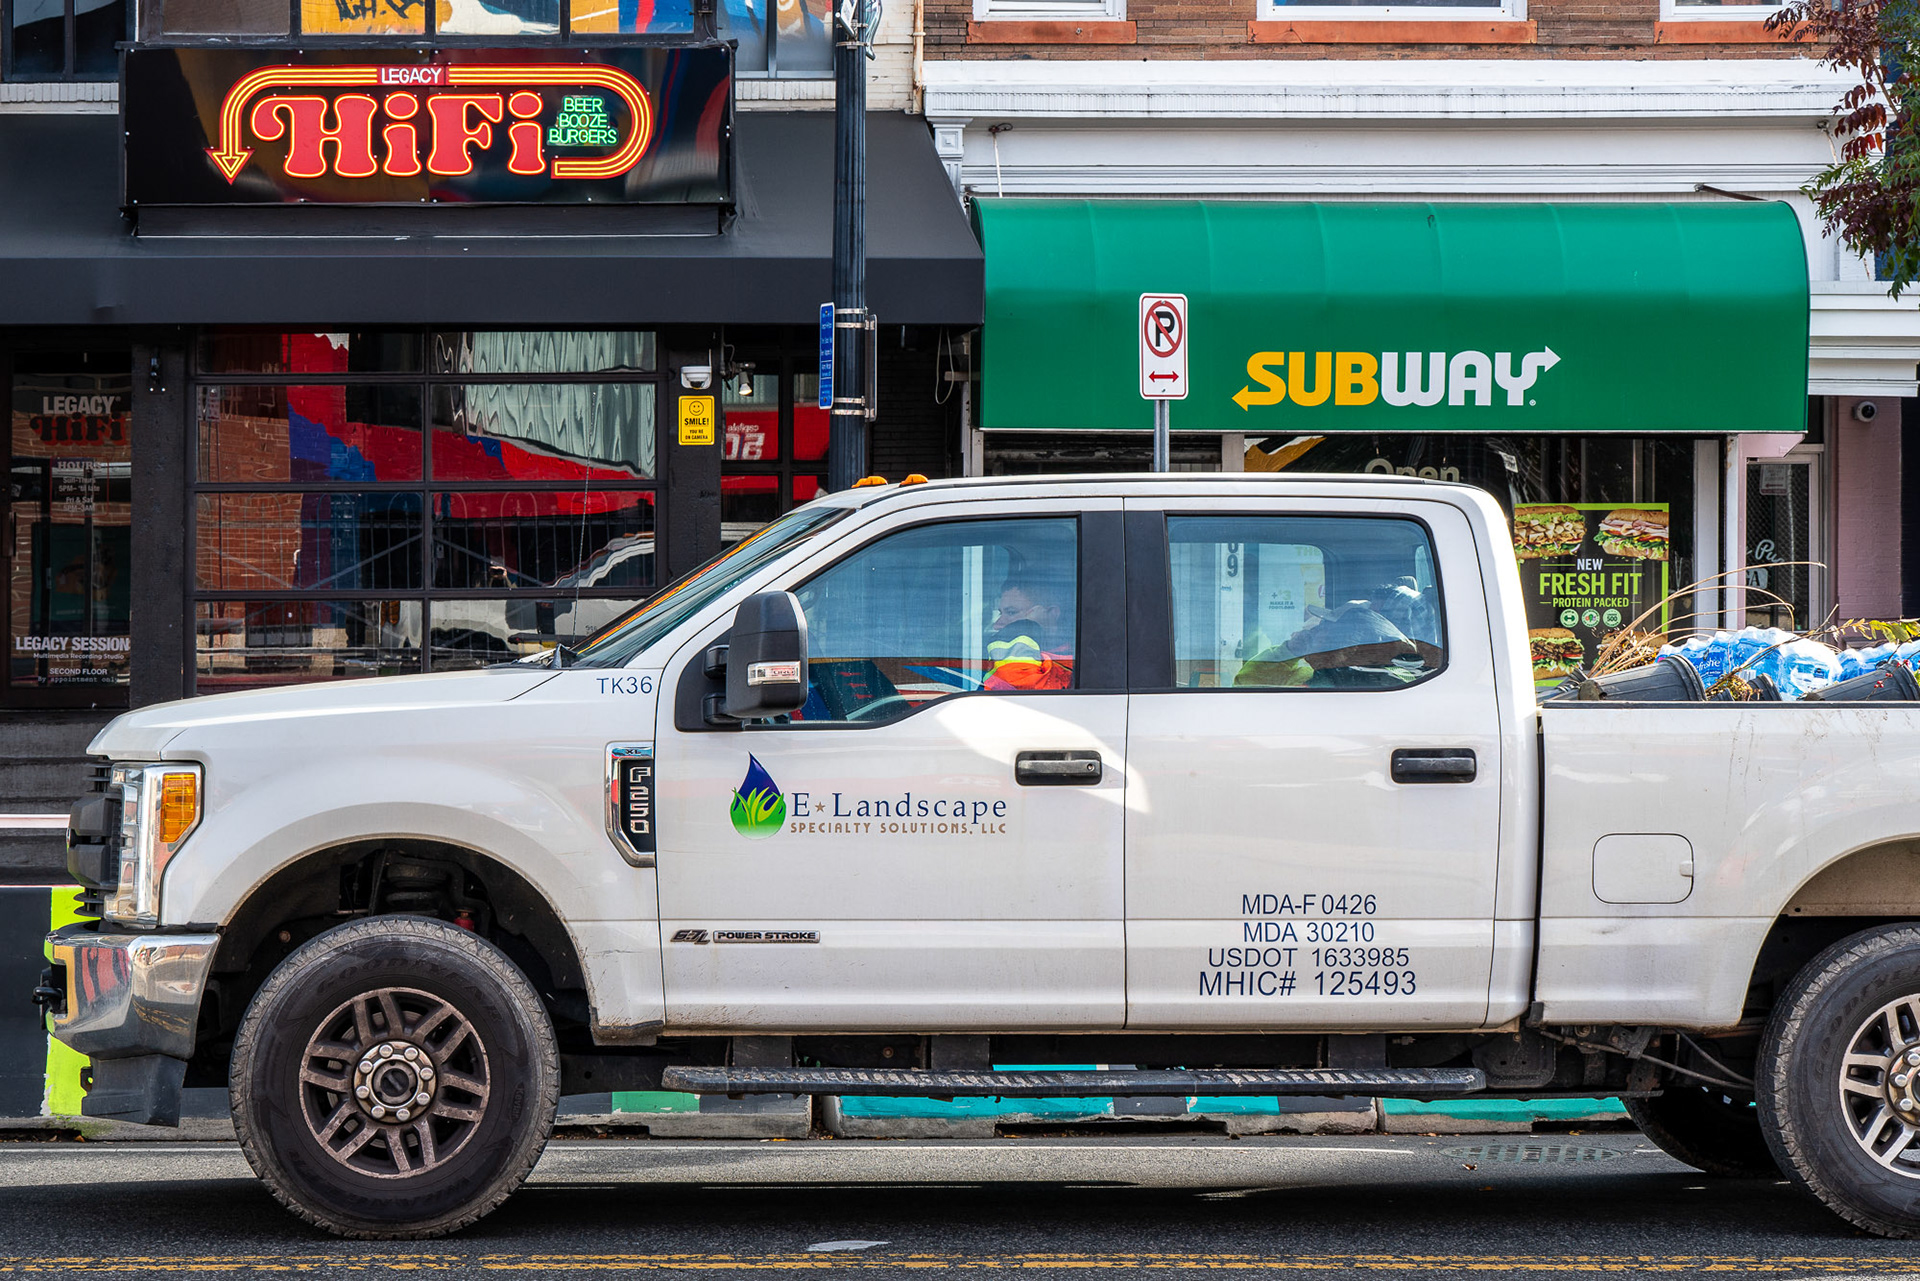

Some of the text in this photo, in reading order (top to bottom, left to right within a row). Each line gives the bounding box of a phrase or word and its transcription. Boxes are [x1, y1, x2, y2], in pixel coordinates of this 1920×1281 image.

[381, 67, 442, 84] LEGACY
[563, 97, 604, 112] BEER
[558, 113, 608, 128] BOOZE
[251, 90, 547, 178] HiFi
[548, 129, 617, 144] BURGERS
[1232, 345, 1561, 411] SUBWAY
[43, 396, 115, 415] LEGACY
[30, 412, 127, 446] HiFi
[684, 417, 709, 426] SMILE!
[57, 461, 102, 471] HOURS
[1576, 558, 1603, 571] NEW
[1539, 572, 1643, 596] FRESH FIT
[1552, 597, 1630, 608] PROTEIN PACKED
[15, 636, 69, 651] LEGACY
[33, 652, 125, 660] Multimedia Recording Studio
[37, 676, 46, 684] By
[596, 675, 653, 695] TK36
[629, 766, 651, 834] F250
[791, 792, 1007, 825] E Landscape
[790, 822, 872, 834] SPECIALTY
[981, 823, 1007, 834] LLC
[1242, 894, 1377, 915] MDA-F 0426
[1243, 922, 1375, 943] MDA 30210
[1208, 948, 1410, 967] USDOT 1633985
[1199, 971, 1417, 996] MHIC# 125493
